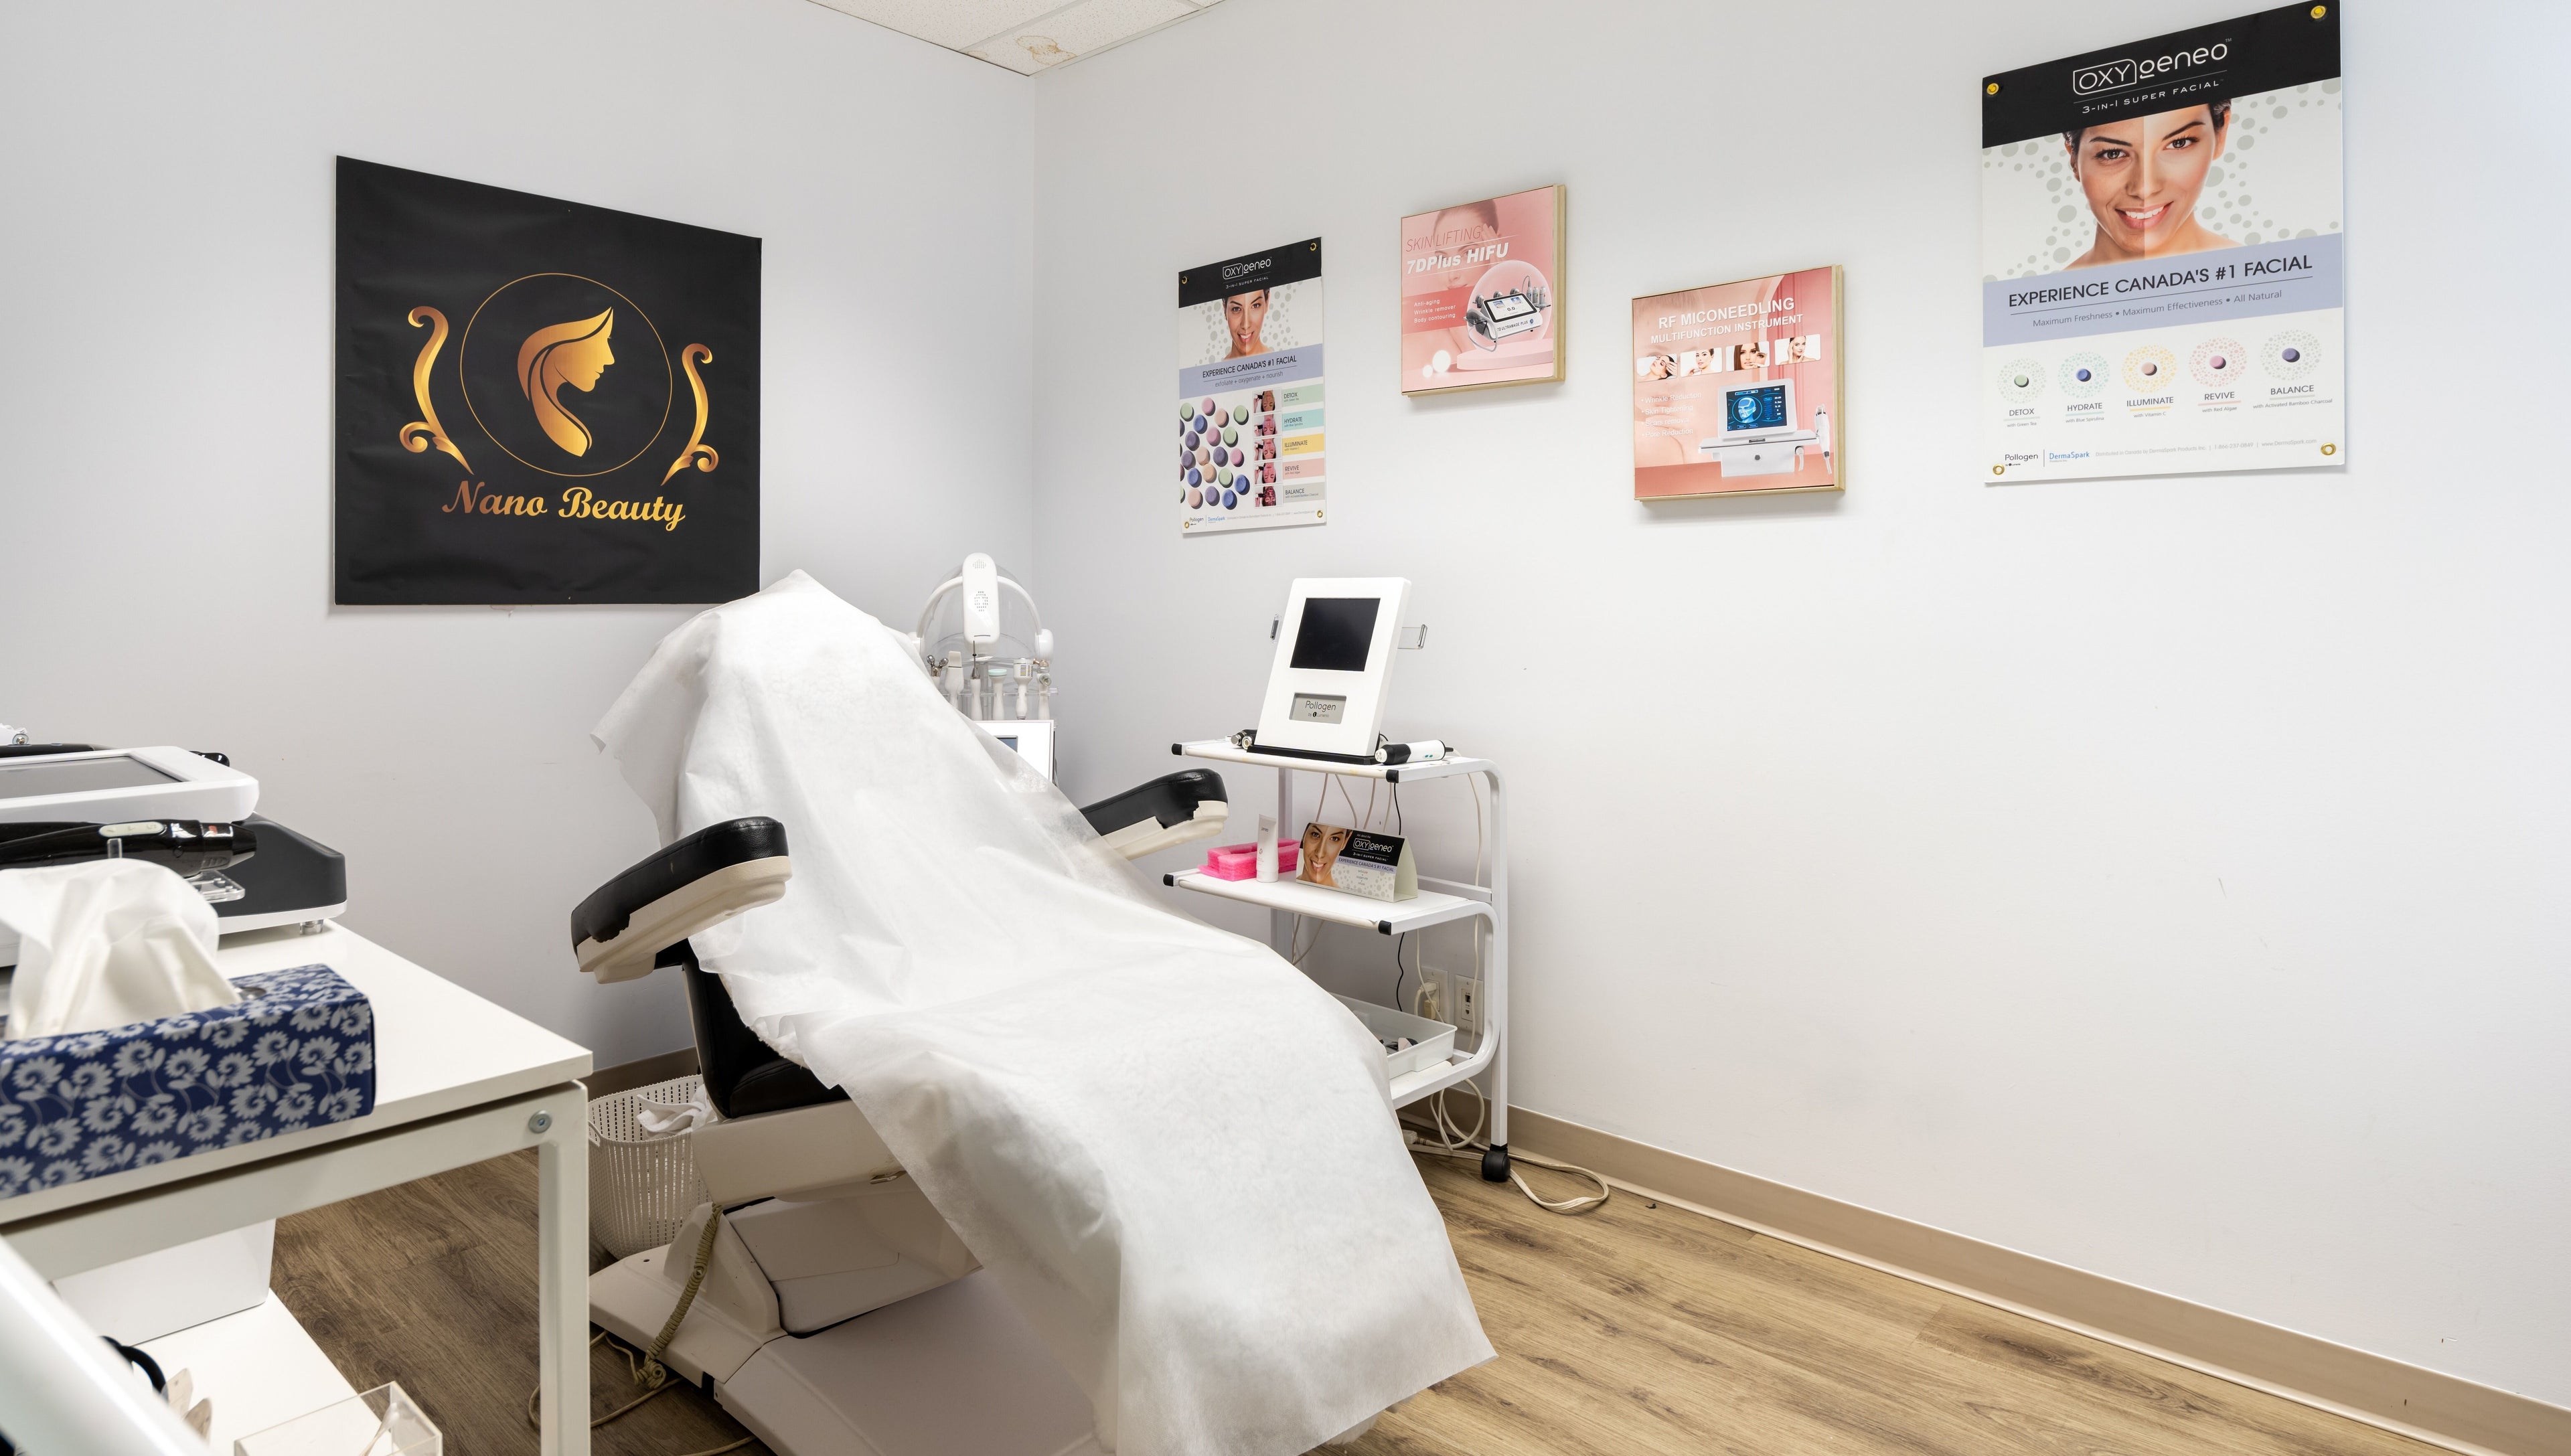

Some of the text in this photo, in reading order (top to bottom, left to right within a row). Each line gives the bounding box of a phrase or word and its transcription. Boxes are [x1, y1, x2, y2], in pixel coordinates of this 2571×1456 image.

[2124, 91, 2166, 105] SUPER
[2173, 80, 2219, 95] FACIAL
[1406, 226, 1481, 252] SKIN LIFTING
[1407, 242, 1509, 274] 7DPlus HIFU
[2009, 254, 2313, 307] EXPERIENCE CANADA'S #1 FACIAL
[1658, 297, 1795, 329] RF MICONEEDLING
[2033, 290, 2282, 327] Maximum Freshness Maximum Effectiveness All Natural
[1650, 313, 1804, 344] MULTIFUNCTION INSTRUMENT
[1202, 366, 1236, 378] EXPERIENCE
[1237, 360, 1267, 372] CANADA'S
[1276, 355, 1297, 365] FACIAL
[1215, 379, 1233, 388] exfoliate
[1238, 375, 1261, 384] oxygenate
[1266, 370, 1283, 379] nourish
[2204, 392, 2235, 400] REVIVE
[2270, 385, 2315, 395] BALANCE
[1670, 392, 1701, 401] Reduction
[2126, 396, 2174, 407] ILLUMINATE
[1660, 405, 1693, 414] Tightening
[2009, 408, 2035, 416] DETOX
[2067, 402, 2103, 412] HYDRATE
[1284, 440, 1308, 448] ILLUMINATE
[2005, 454, 2039, 462] Pollogen
[2049, 451, 2090, 460] DermaSpark
[441, 480, 686, 532] Nano Beauty
[1305, 700, 1336, 713] Pollogen
[1338, 857, 1358, 866] EXPERIENCE
